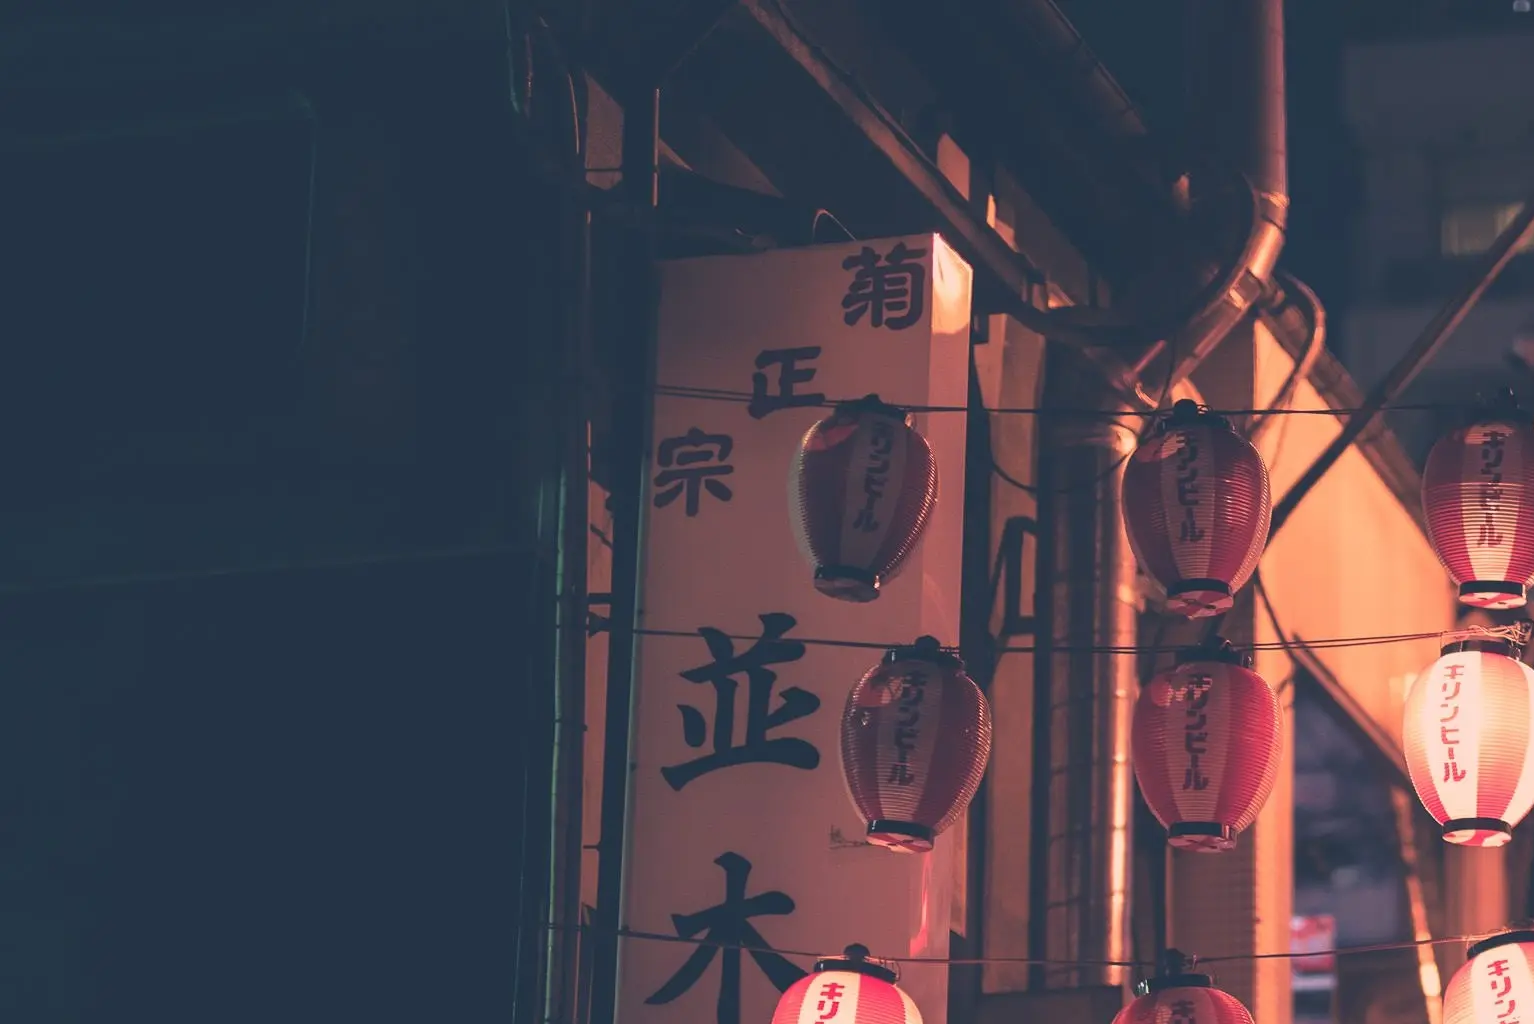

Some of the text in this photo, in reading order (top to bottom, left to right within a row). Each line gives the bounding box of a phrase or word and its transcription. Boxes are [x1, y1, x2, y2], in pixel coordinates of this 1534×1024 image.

[1440, 664, 1466, 782] キリンビール
